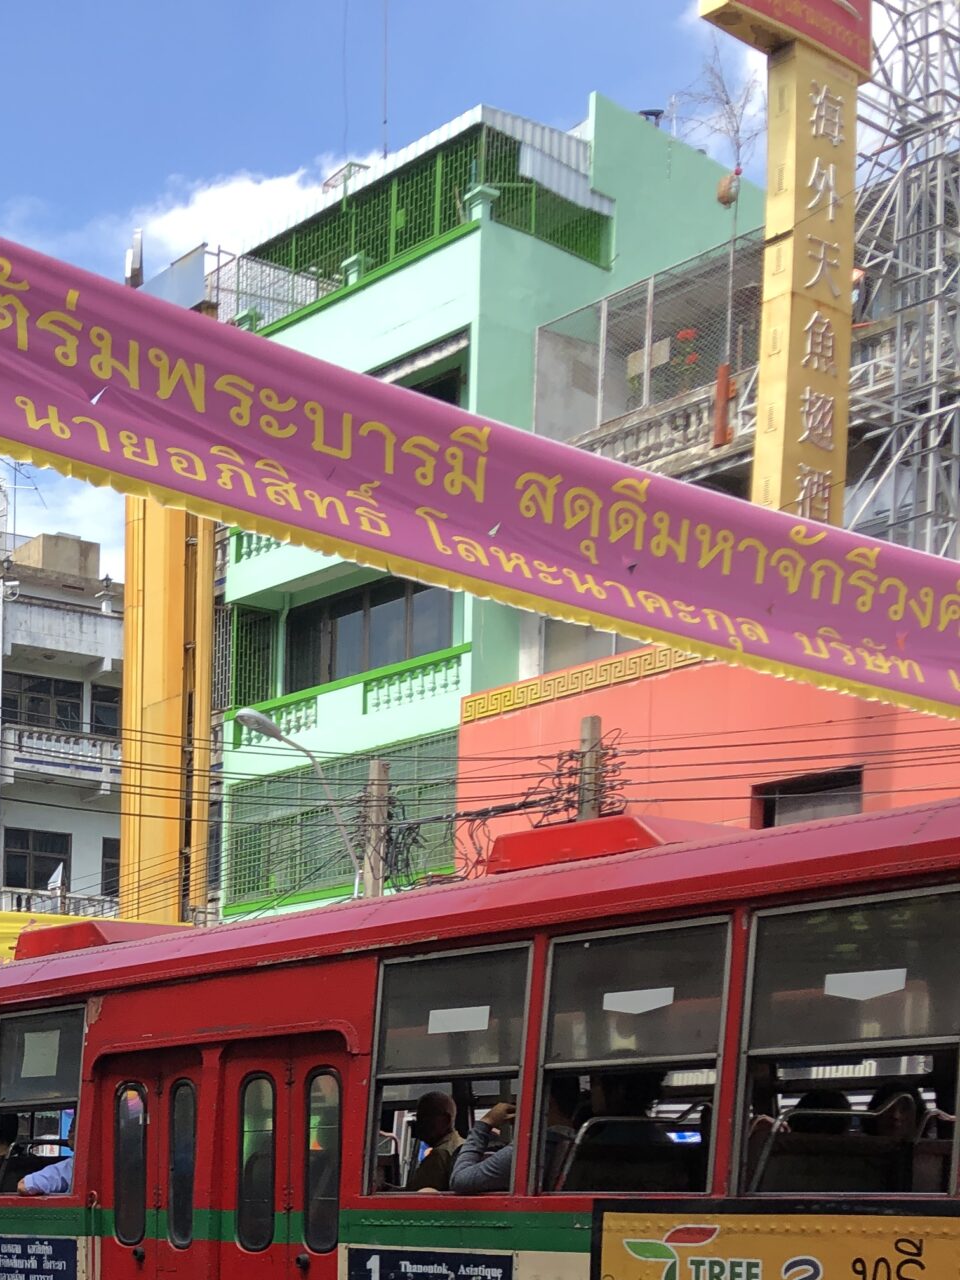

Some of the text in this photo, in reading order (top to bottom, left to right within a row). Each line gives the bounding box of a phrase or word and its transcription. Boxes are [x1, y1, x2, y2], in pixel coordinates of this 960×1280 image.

[15, 395, 391, 537] นายอภิสิทธิ์
